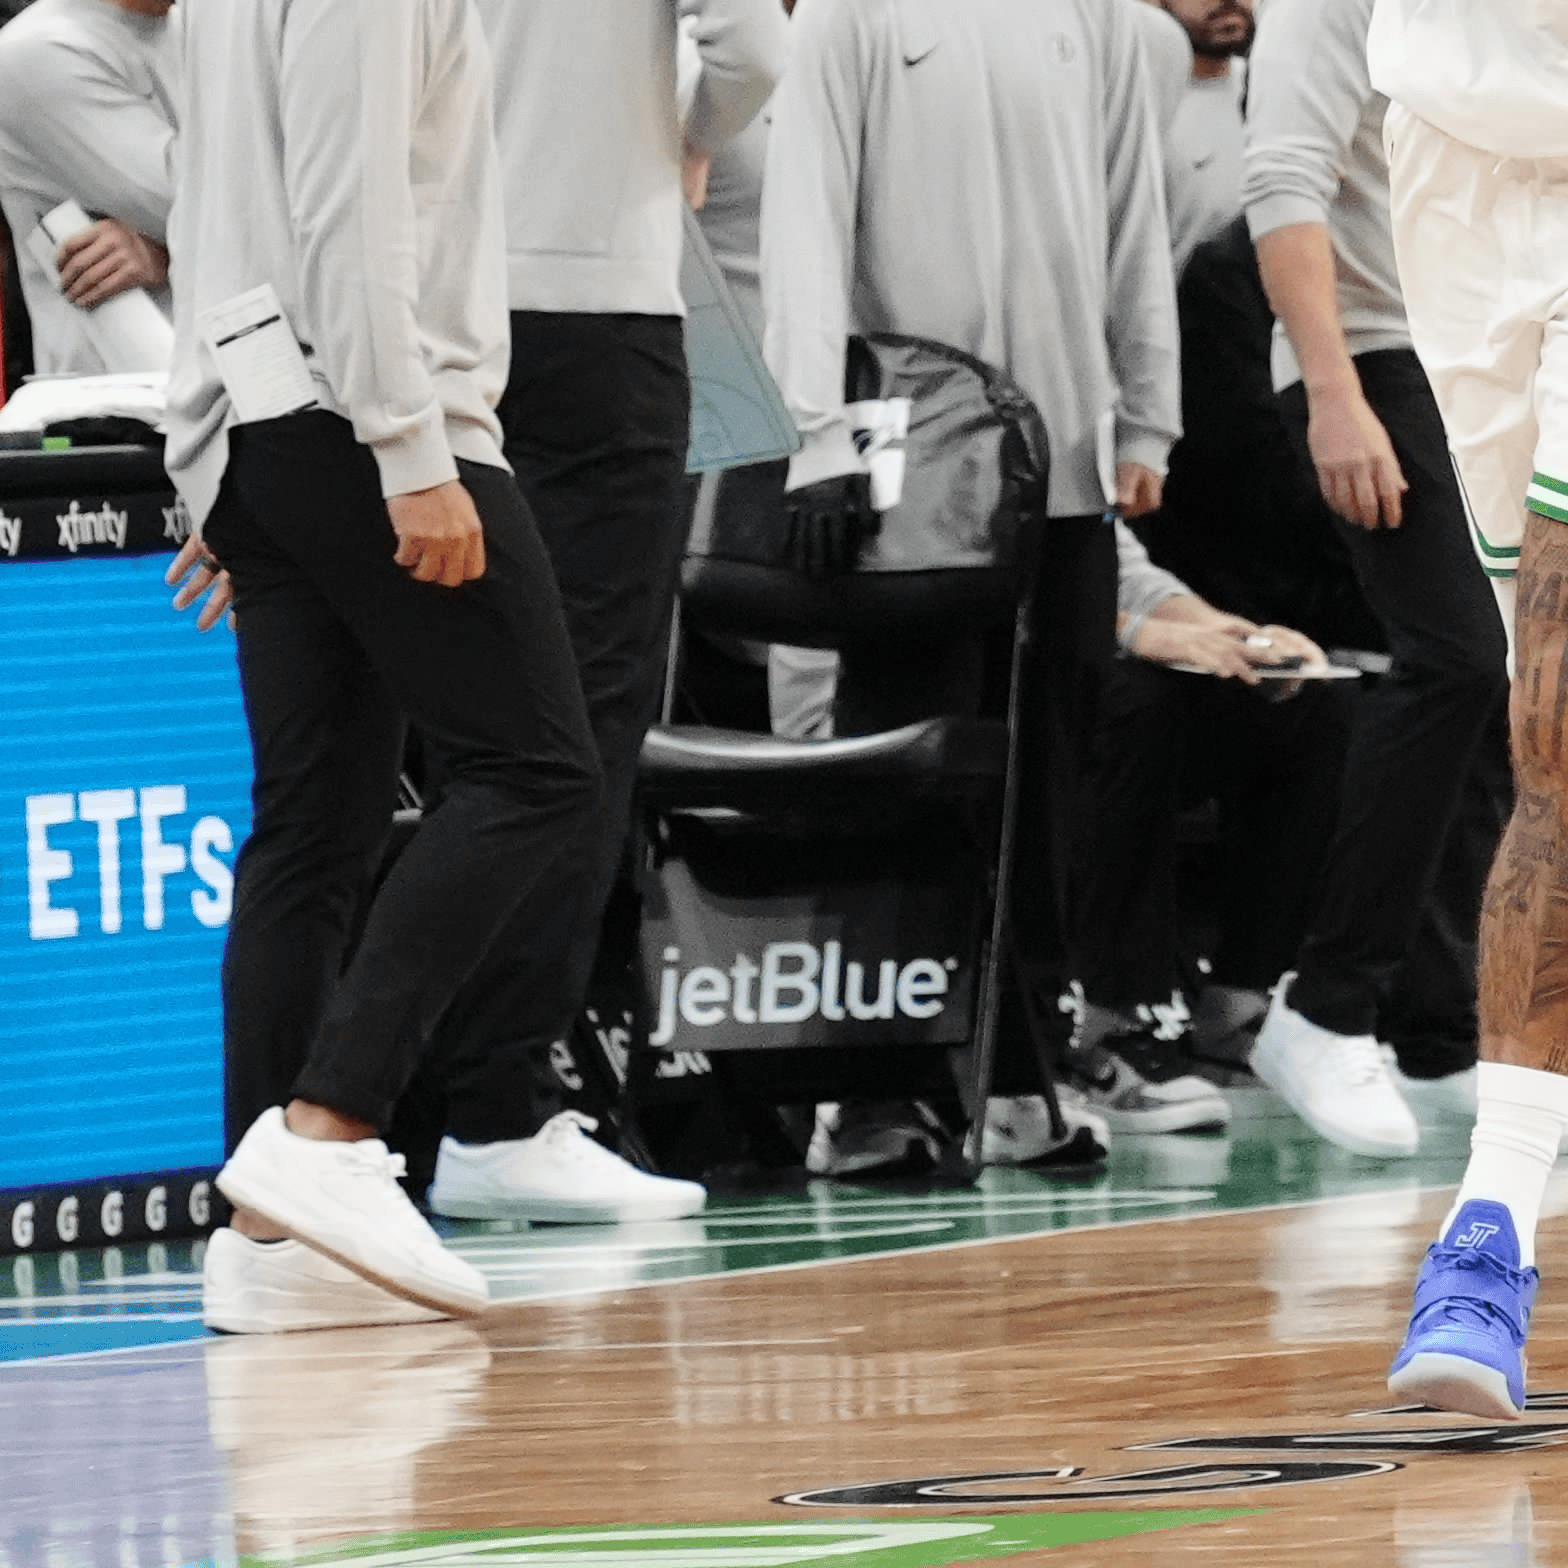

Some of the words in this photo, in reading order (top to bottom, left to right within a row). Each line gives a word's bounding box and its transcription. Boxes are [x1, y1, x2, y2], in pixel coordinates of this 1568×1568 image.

[56, 499, 128, 553] xfinity
[25, 783, 235, 942] ETFs
[648, 940, 949, 1047] jetBlue
